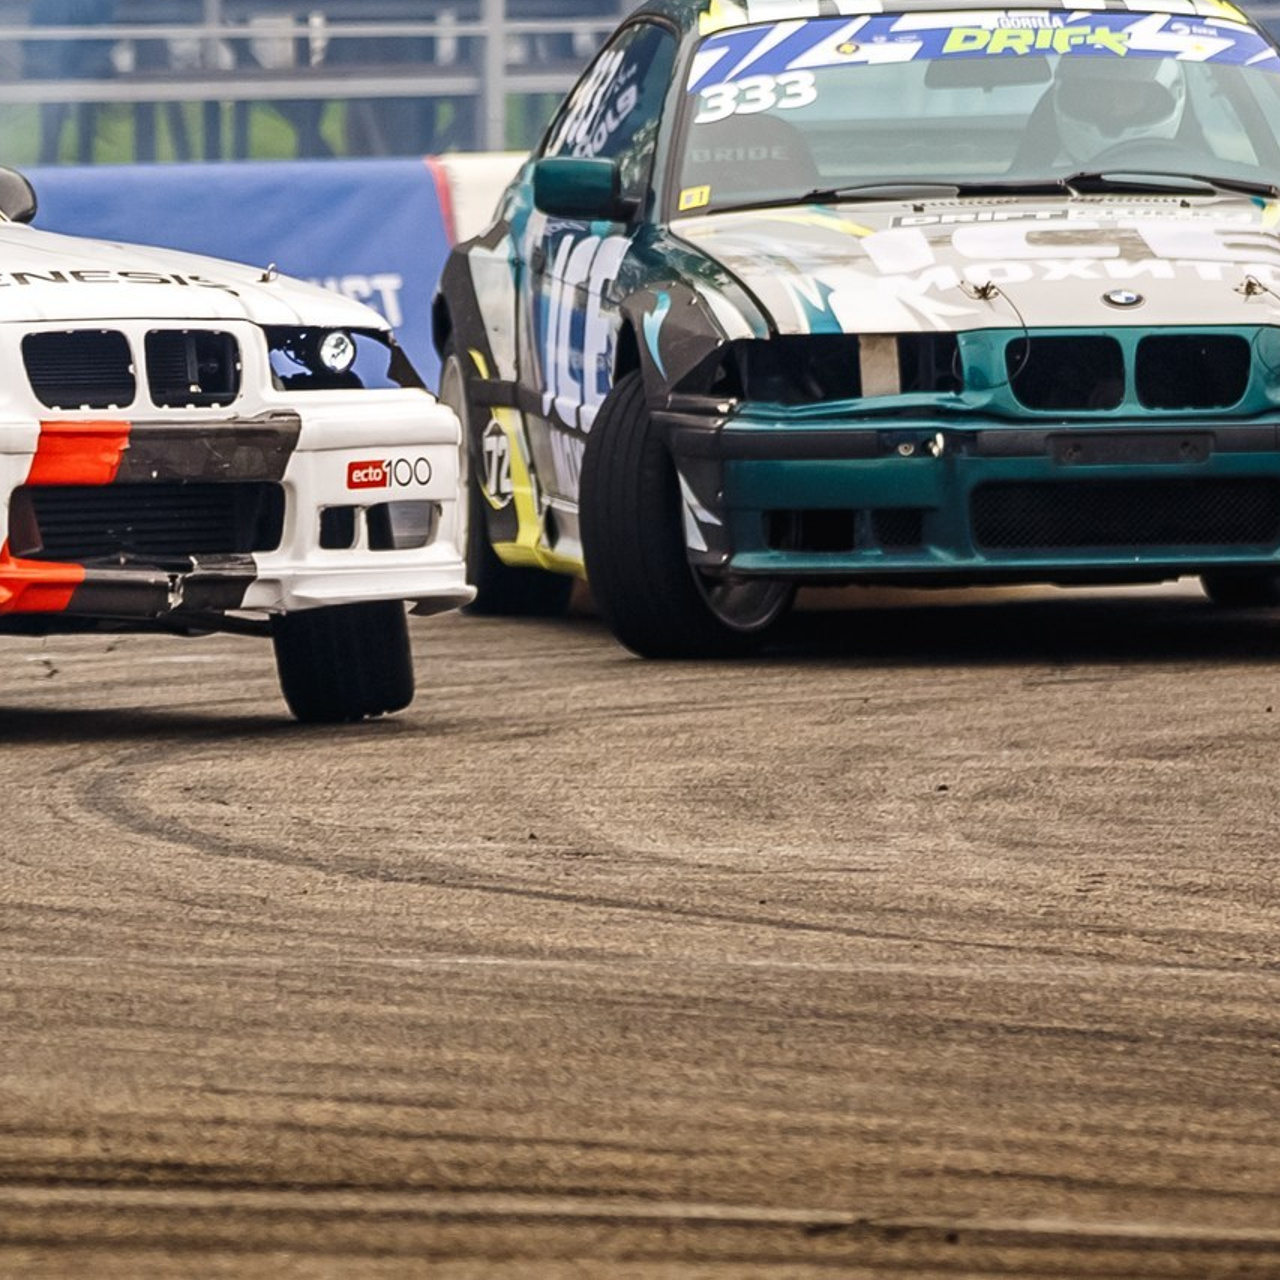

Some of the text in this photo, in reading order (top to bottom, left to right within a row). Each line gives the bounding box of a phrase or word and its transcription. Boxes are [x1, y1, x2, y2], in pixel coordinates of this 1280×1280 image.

[998, 15, 1064, 29] GORILLA
[942, 26, 1132, 57] DRIFT
[694, 70, 818, 124] 333
[692, 146, 790, 163] BRIDE
[875, 258, 1280, 297] МОХИТ
[352, 457, 433, 487] ecto100
